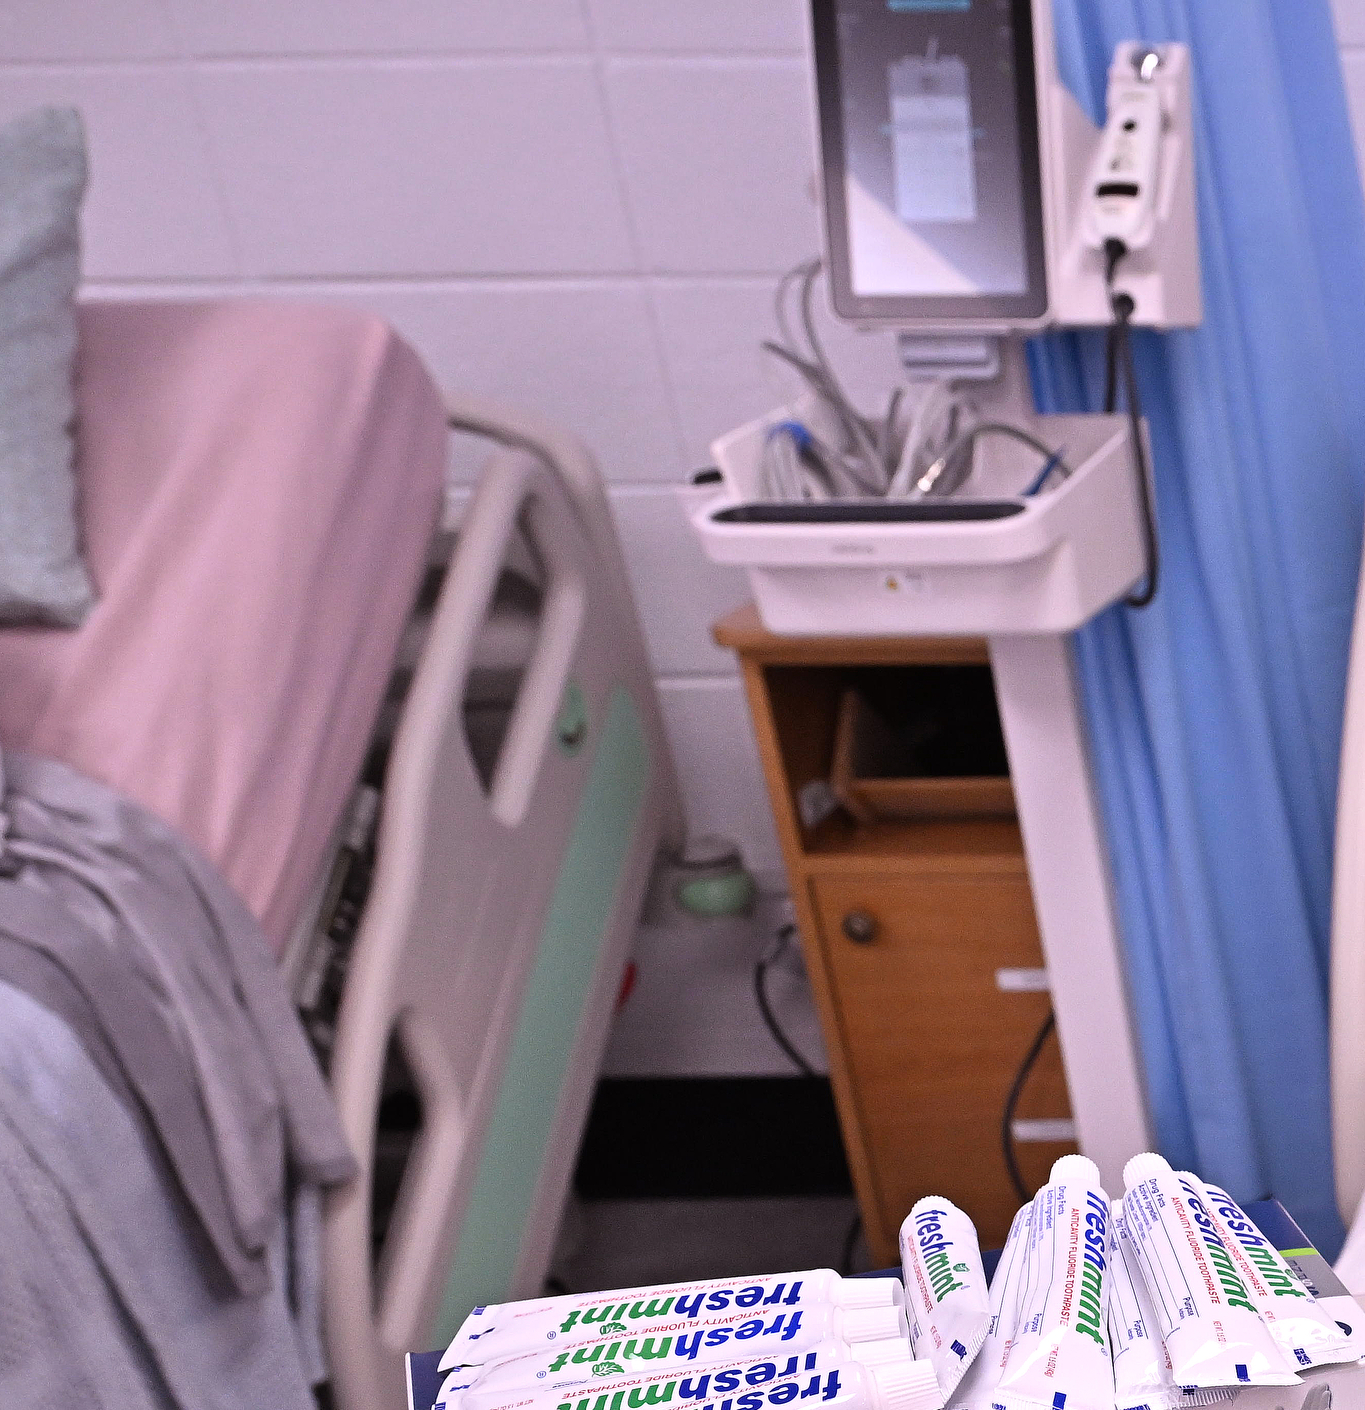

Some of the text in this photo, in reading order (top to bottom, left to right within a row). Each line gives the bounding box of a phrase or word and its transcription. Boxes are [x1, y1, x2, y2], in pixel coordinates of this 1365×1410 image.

[915, 1208, 964, 1302] freshmint
[1060, 1208, 1079, 1326] ANTICAVITY FLUORIDE TOOTHPASTE
[1172, 1197, 1220, 1304] ANTICAVITY FLUORIDE TOOTHPASTE
[1207, 1190, 1306, 1298] freshmint
[548, 1310, 804, 1372] freshmint
[560, 1280, 804, 1333] freshmint
[638, 1320, 700, 1336] FLUORIDE
[702, 1310, 770, 1326] ANTICAVITY
